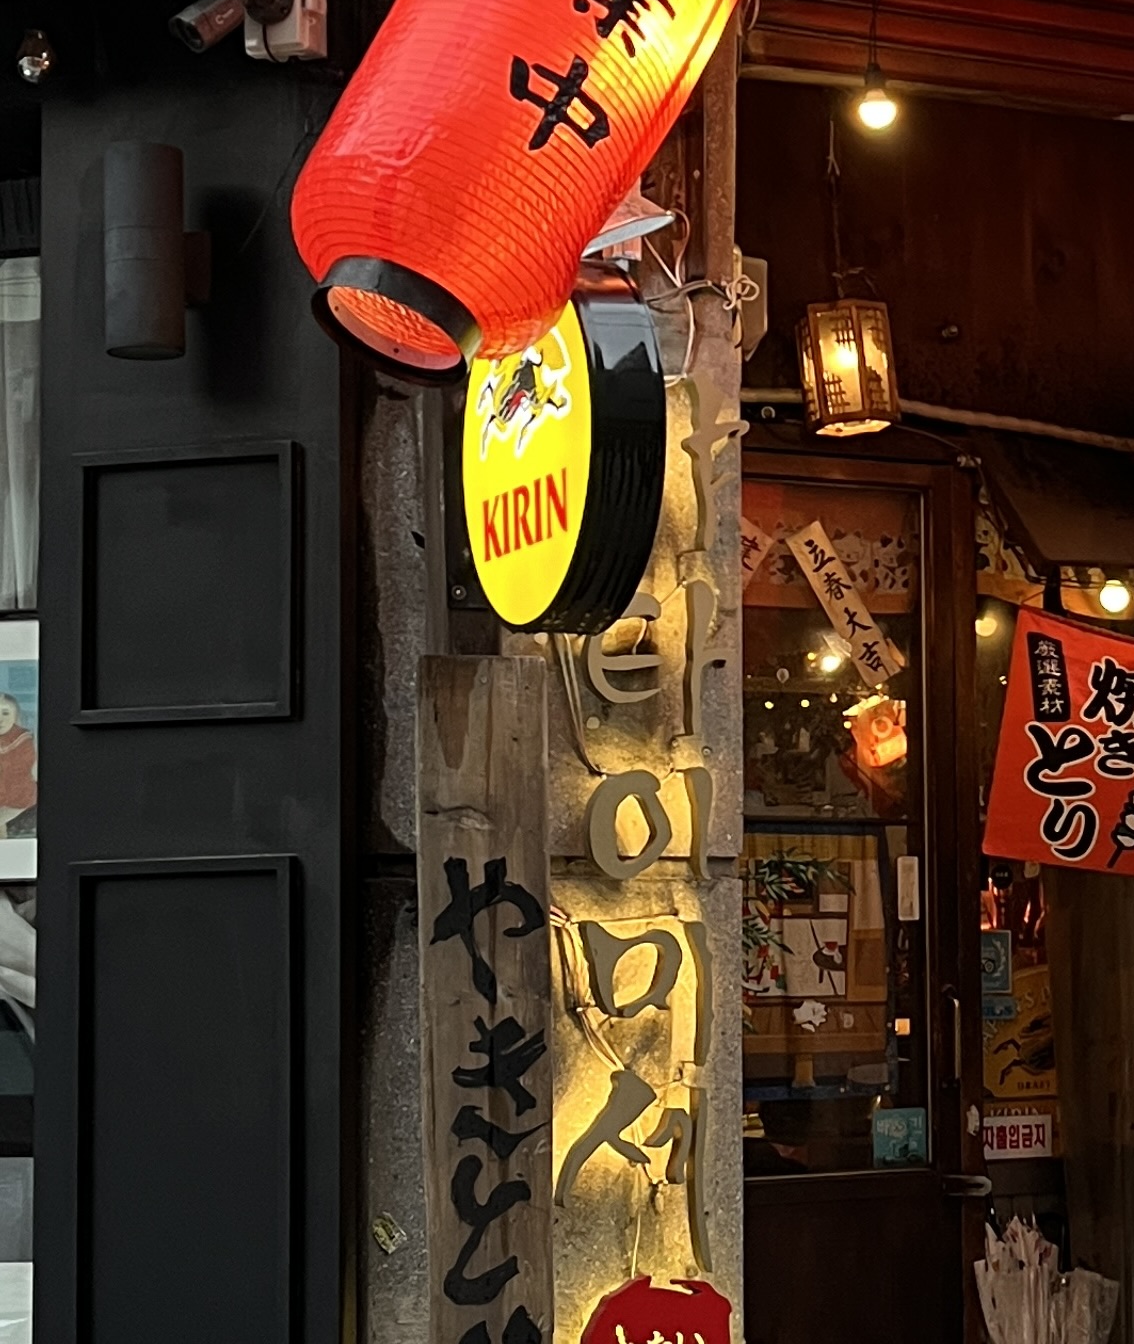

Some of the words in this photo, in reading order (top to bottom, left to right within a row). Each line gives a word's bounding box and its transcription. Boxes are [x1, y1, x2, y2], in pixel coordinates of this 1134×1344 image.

[482, 467, 569, 563] KIRIN
[803, 537, 887, 673] 立春大吉
